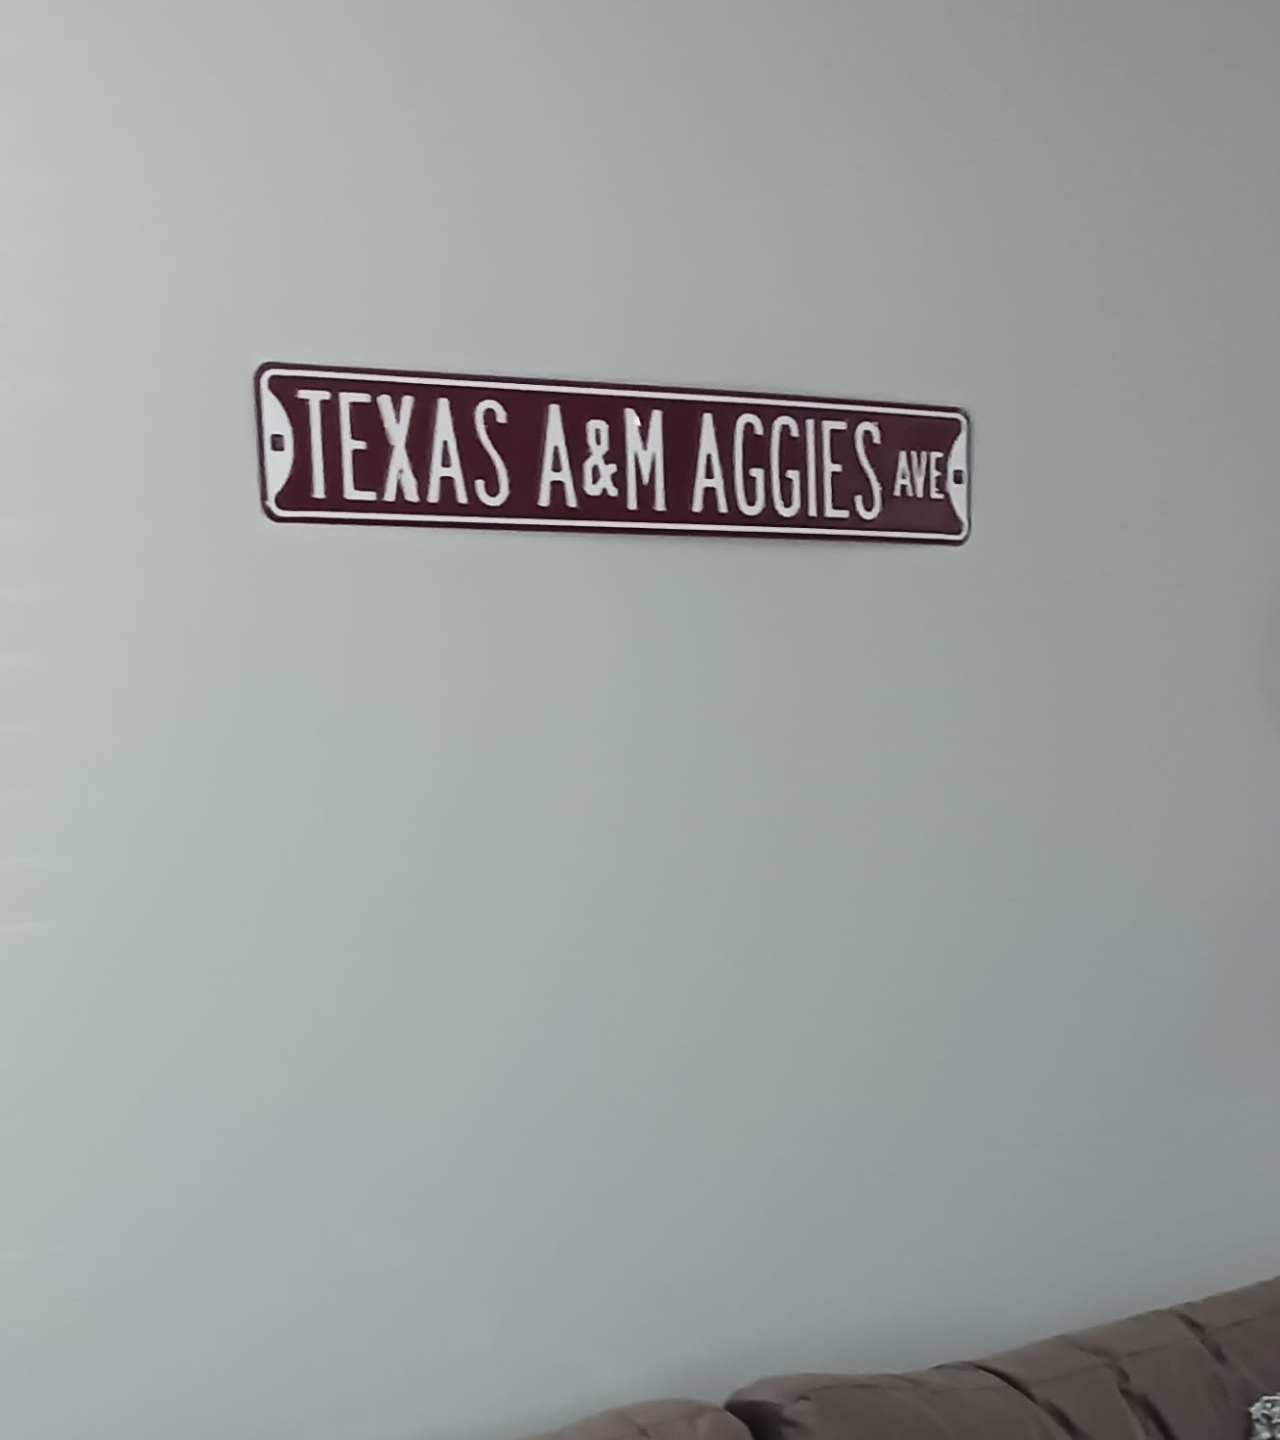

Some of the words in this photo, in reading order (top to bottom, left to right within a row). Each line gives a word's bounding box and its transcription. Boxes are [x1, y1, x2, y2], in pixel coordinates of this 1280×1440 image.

[297, 388, 510, 507] TEXAS
[536, 403, 667, 512] A&M
[691, 412, 883, 520] AGGIES
[893, 450, 945, 499] AVE
